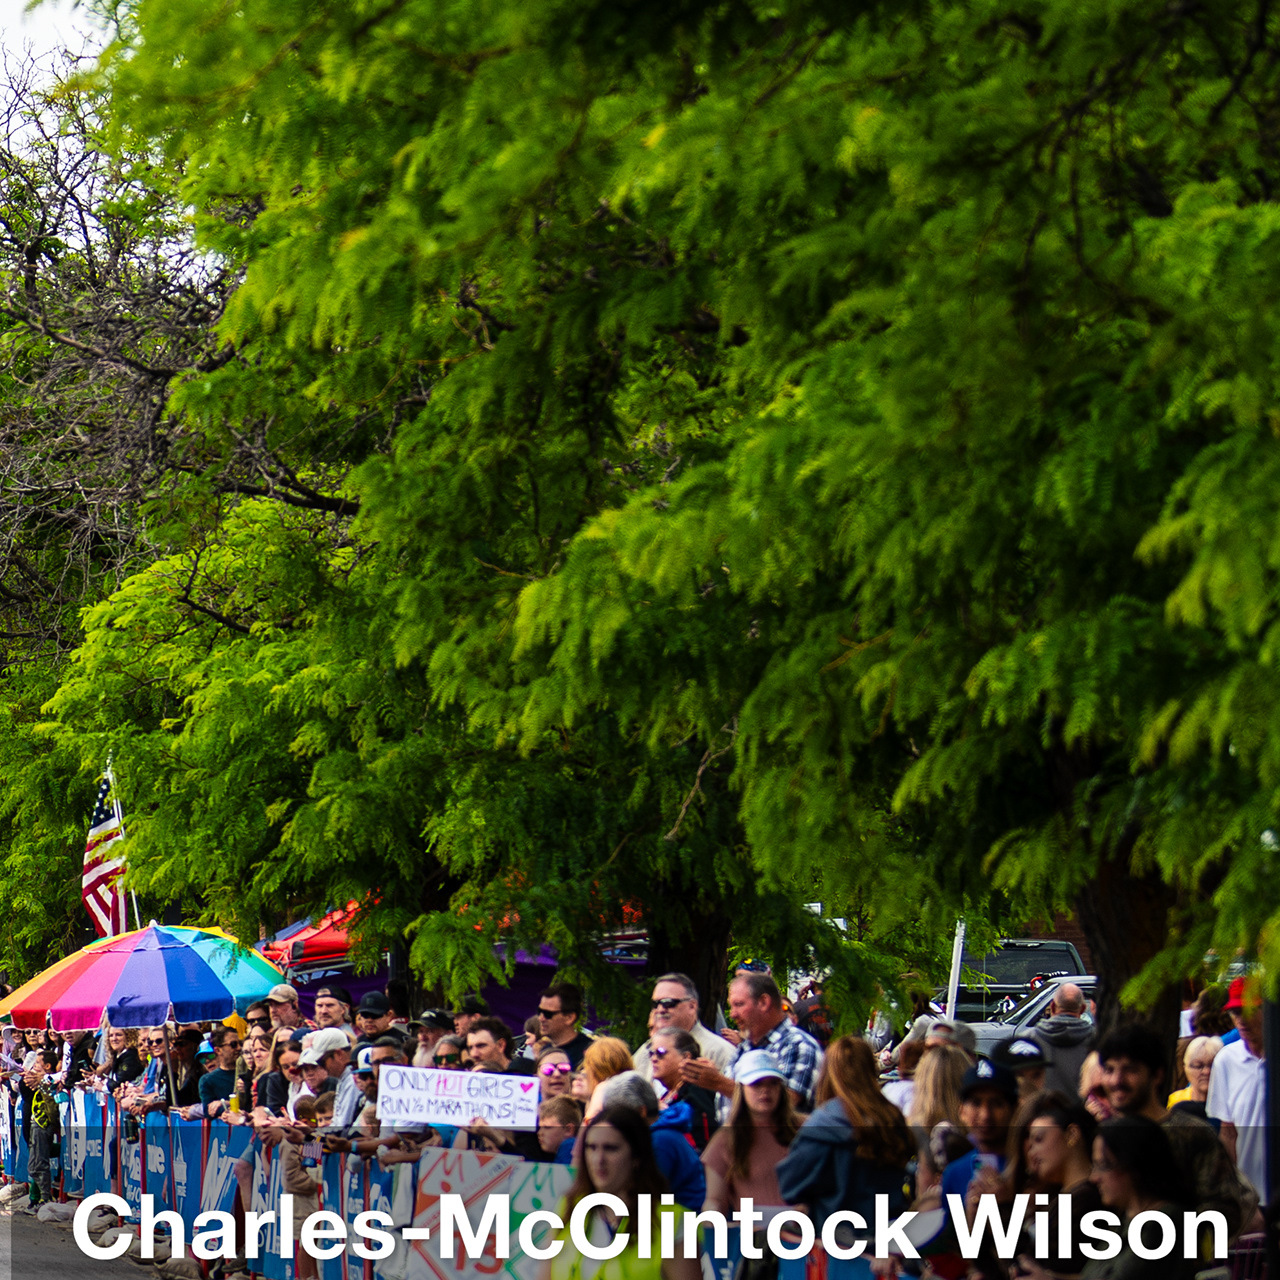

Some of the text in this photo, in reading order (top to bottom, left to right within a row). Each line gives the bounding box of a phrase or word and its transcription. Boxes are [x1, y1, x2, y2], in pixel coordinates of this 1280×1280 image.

[385, 1068, 515, 1099] ONLY HOT GIRLS
[380, 1095, 410, 1116] RUN
[426, 1099, 517, 1124] MARATHONS!
